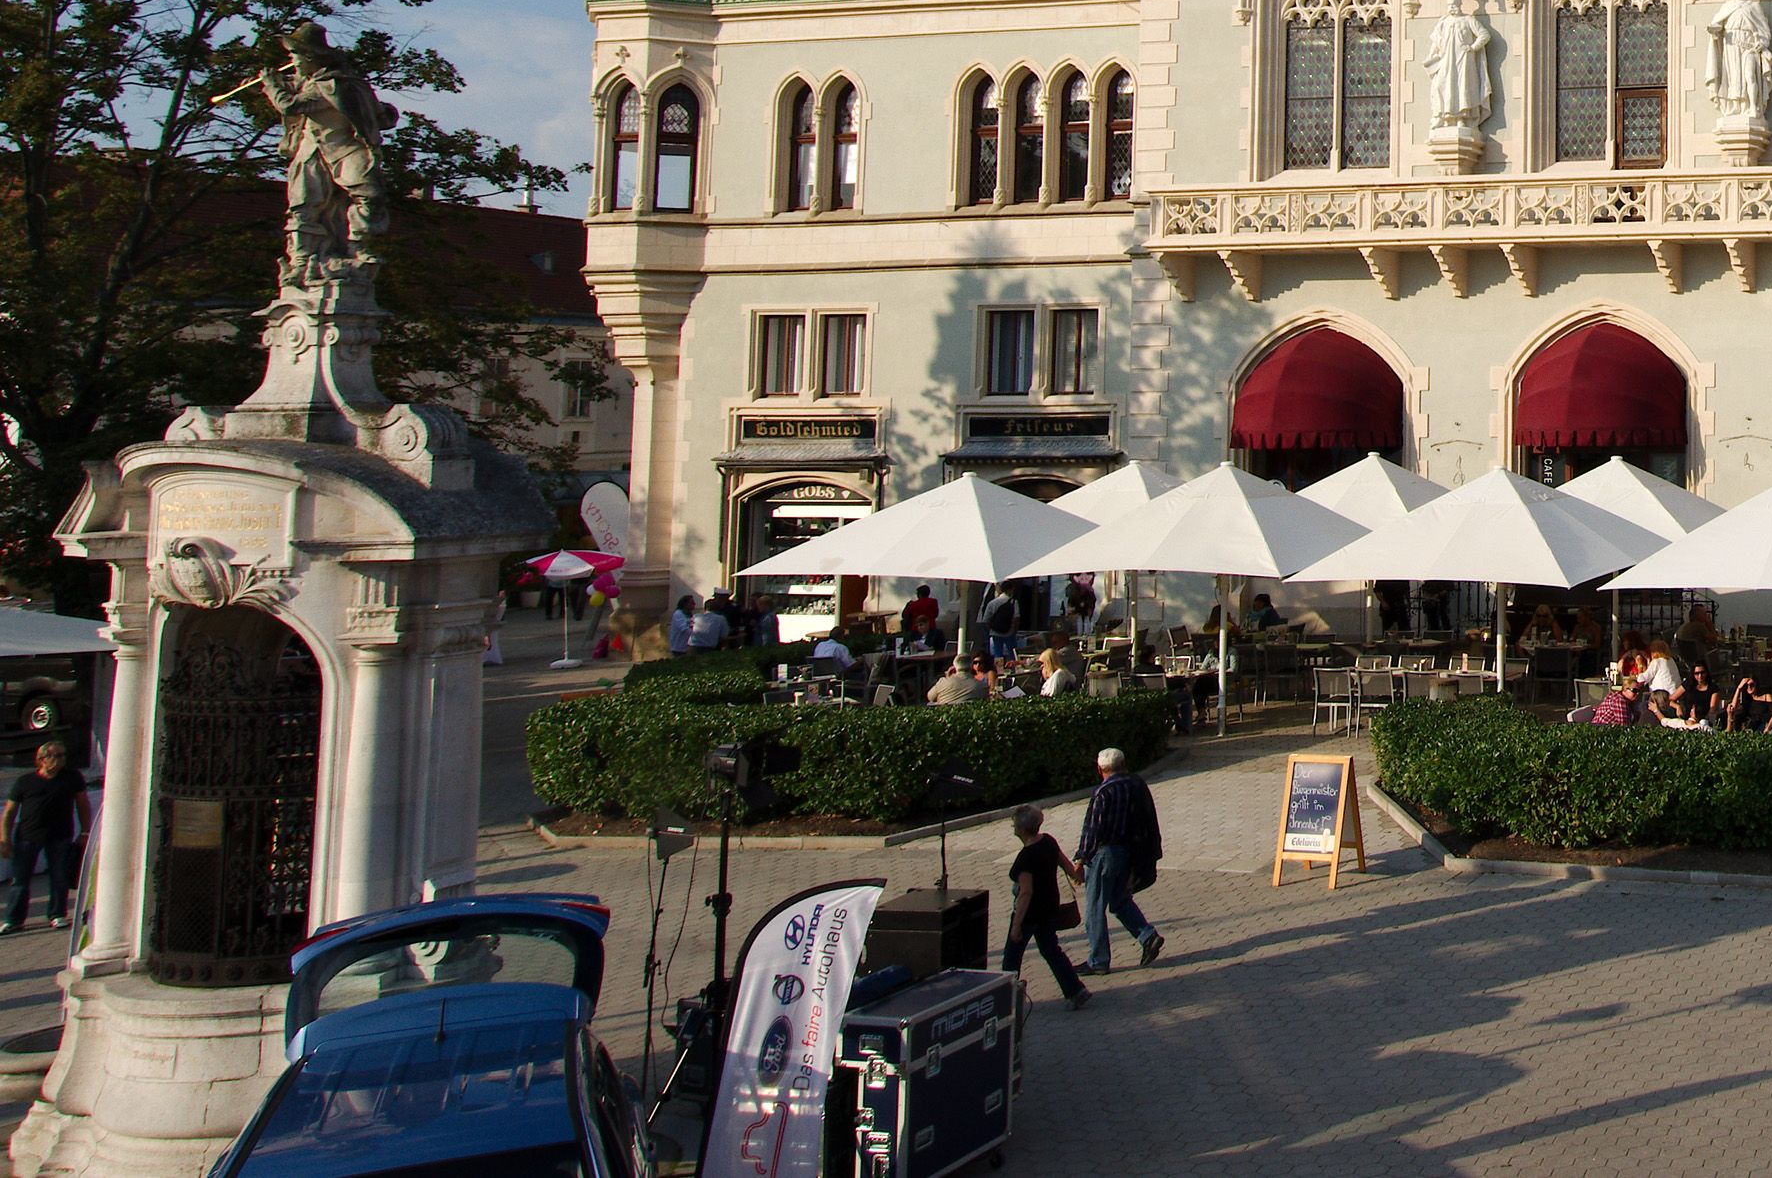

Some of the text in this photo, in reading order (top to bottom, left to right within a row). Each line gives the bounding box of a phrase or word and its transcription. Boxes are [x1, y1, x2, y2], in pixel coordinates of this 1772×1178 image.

[792, 485, 836, 499] GOLS
[801, 903, 825, 966] HYUNDAI
[792, 907, 848, 1092] Das faire Autohaus
[931, 994, 995, 1041] MIDAS
[763, 1033, 787, 1074] Ford
